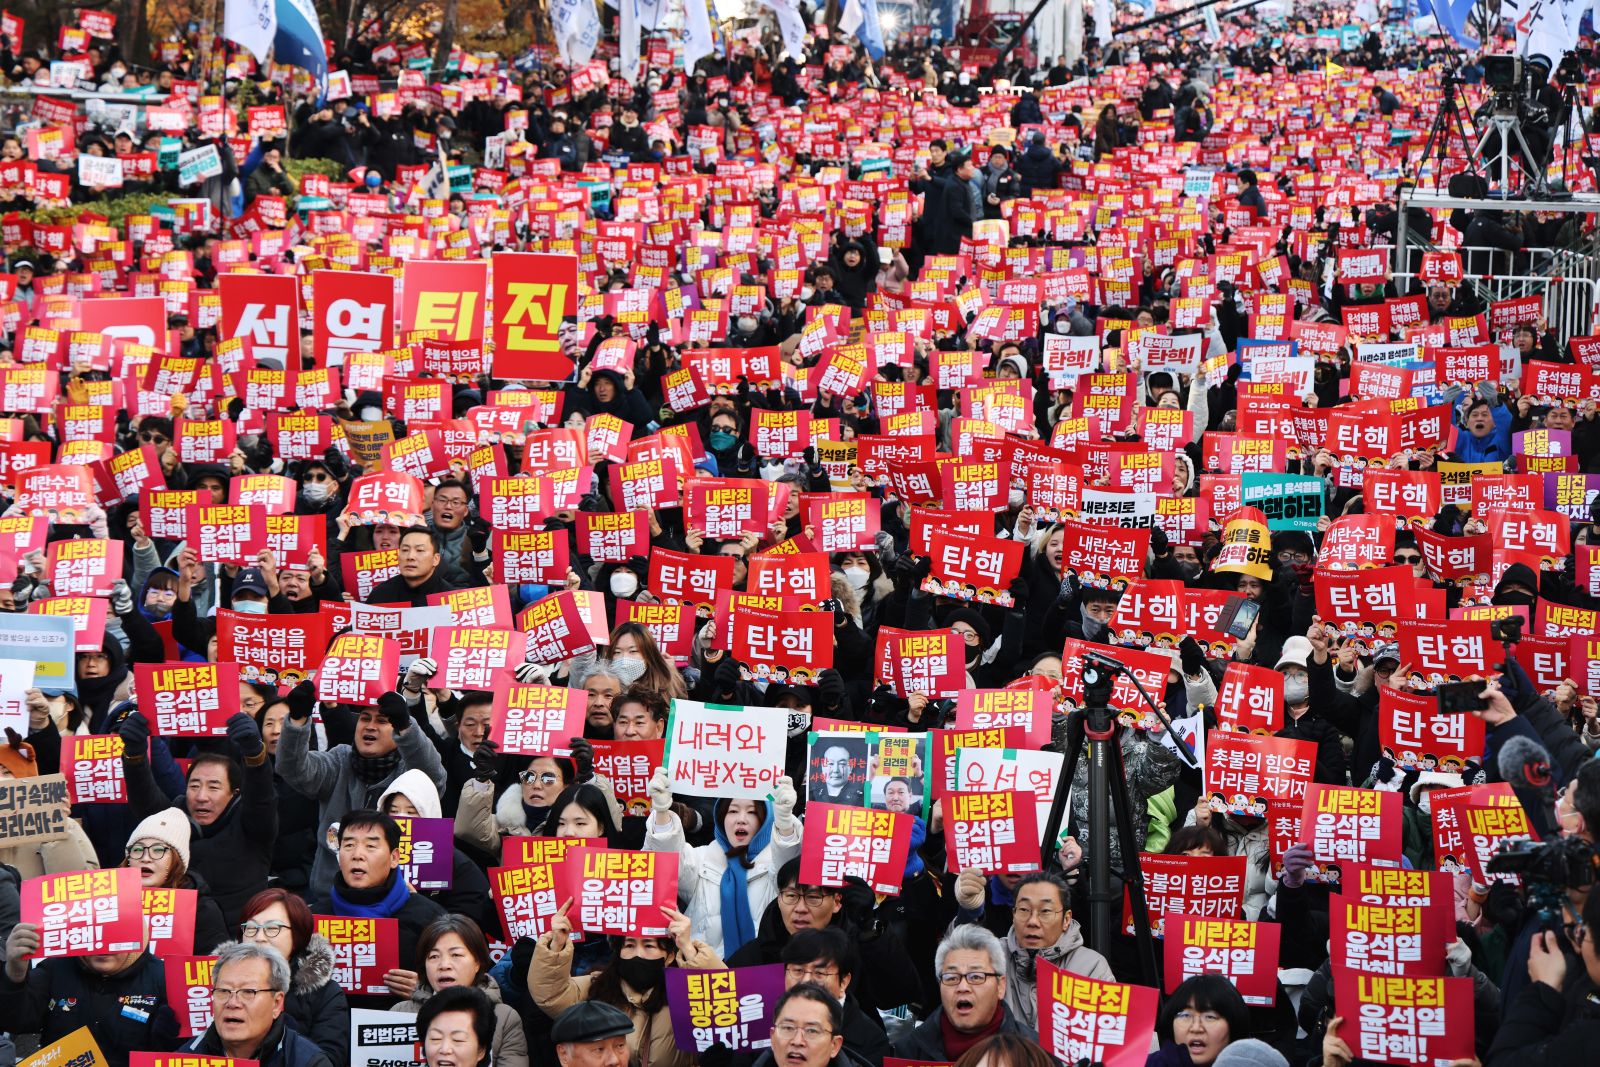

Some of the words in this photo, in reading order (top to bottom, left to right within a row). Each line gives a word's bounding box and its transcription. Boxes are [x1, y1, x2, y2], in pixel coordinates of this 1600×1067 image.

[1425, 260, 1459, 277] 탄핵
[413, 291, 480, 346] 퇴
[502, 281, 568, 352] 진
[1347, 312, 1380, 324] 윤석열을
[1390, 301, 1420, 314] 윤석열을
[233, 303, 291, 369] 석
[326, 298, 387, 368] 열
[873, 331, 906, 344] 내란죄
[1301, 330, 1337, 342] 내란수괴
[425, 348, 450, 361] 촛불의
[451, 347, 480, 360] 힘으로
[872, 343, 906, 357] 윤석열
[1147, 346, 1195, 367] 탄핵!
[1446, 355, 1489, 369] 윤석열을
[5, 369, 46, 384] 내란죄
[247, 369, 285, 384] 내란죄
[424, 360, 451, 373] 나라를
[452, 359, 481, 373] 지키자
[1359, 370, 1403, 385] 윤석열을
[1446, 367, 1489, 382] 탄핵하라
[247, 383, 285, 398] 윤석열
[404, 384, 441, 399] 내란죄
[278, 416, 319, 431] 내란죄
[1146, 409, 1184, 424] 내란죄
[1400, 416, 1441, 443] 탄핵
[1232, 439, 1274, 454] 내란죄
[1337, 423, 1389, 453] 탄핵
[1523, 430, 1548, 443] 퇴진
[529, 440, 577, 467] 탄핵
[871, 445, 922, 460] 내란수괴
[358, 481, 410, 509] 탄핵
[892, 473, 932, 499] 탄핵
[1244, 484, 1283, 500] 내란수괴
[1557, 475, 1586, 490] 퇴진
[18, 491, 62, 509] 윤석열
[62, 490, 88, 508] 체포
[1080, 501, 1136, 514] 내란죄로
[1374, 481, 1428, 513] 탄핵
[1502, 522, 1558, 553] 탄핵
[942, 543, 1004, 583] 탄핵
[1319, 543, 1356, 564] 윤석열
[1360, 542, 1387, 562] 체포
[1422, 541, 1475, 574] 탄핵
[660, 564, 717, 598] 탄핵
[758, 567, 817, 600] 탄핵
[523, 596, 563, 630] 내란죄
[1113, 594, 1178, 630] 탄핵
[1330, 581, 1397, 618] 탄핵
[1546, 604, 1597, 628] 내란죄
[232, 624, 306, 648] 윤석열을
[449, 633, 508, 656] 내란죄
[525, 616, 570, 652] 윤석열
[746, 623, 813, 666] 탄핵
[899, 635, 949, 658] 내란죄
[233, 645, 306, 669] 탄핵하라
[327, 637, 384, 660] 내란죄
[529, 639, 569, 666] 탄핵!
[1416, 633, 1485, 671] 탄핵
[152, 665, 217, 691] 내란죄
[321, 658, 381, 681] 윤석열
[446, 654, 507, 676] 윤석열
[900, 655, 949, 681] 윤석열
[154, 687, 220, 712] 윤석열
[320, 679, 366, 702] 탄핵!
[508, 687, 567, 711] 내란죄
[903, 678, 937, 701] 탄핵!
[972, 688, 1034, 712] 내란죄
[1220, 681, 1273, 724] 탄핵
[157, 711, 208, 736] 탄핵!
[505, 709, 566, 733] 윤석열
[1392, 708, 1466, 752] 탄핵
[74, 737, 126, 761] 내란죄
[503, 731, 551, 754] 탄핵!
[678, 721, 767, 754] 내려와
[1212, 748, 1263, 772] 촛불의
[1265, 755, 1312, 781] 힘으로
[76, 778, 122, 803] 탄핵!
[1209, 771, 1260, 795] 나라를
[1263, 777, 1310, 806] 지키자
[1317, 788, 1381, 816] 내란죄
[952, 792, 1014, 821] 내란죄
[825, 808, 895, 837] 내란죄
[953, 819, 1017, 848] 윤석열
[1314, 813, 1381, 840] 윤석열
[1466, 808, 1529, 836] 내란죄
[824, 834, 893, 863] 윤석열
[957, 845, 1003, 873] 탄핵!
[1313, 837, 1366, 864] 탄핵!
[583, 852, 655, 879] 내란죄
[42, 869, 118, 904] 내란죄
[498, 864, 554, 896] 내란죄
[581, 879, 654, 906] 윤석열
[1191, 873, 1241, 897] 힘으로
[1359, 869, 1430, 897] 내란죄
[42, 896, 119, 930] 윤석열
[503, 889, 557, 921] 윤석열
[580, 906, 636, 933] 탄핵!
[1346, 904, 1422, 935] 내란죄
[43, 923, 104, 957] 탄핵!
[1183, 920, 1257, 948] 내란죄
[1345, 933, 1422, 962] 윤석열
[1182, 946, 1255, 975] 윤석열
[688, 970, 737, 1000] 퇴진
[1052, 972, 1131, 1016] 내란죄
[1357, 975, 1444, 1006] 내란죄
[690, 993, 765, 1027] 광장을
[1051, 1001, 1126, 1046] 윤석열
[1358, 1003, 1446, 1036] 윤석열
[693, 1023, 750, 1053] 열자!
[1359, 1032, 1428, 1064] 탄핵!
